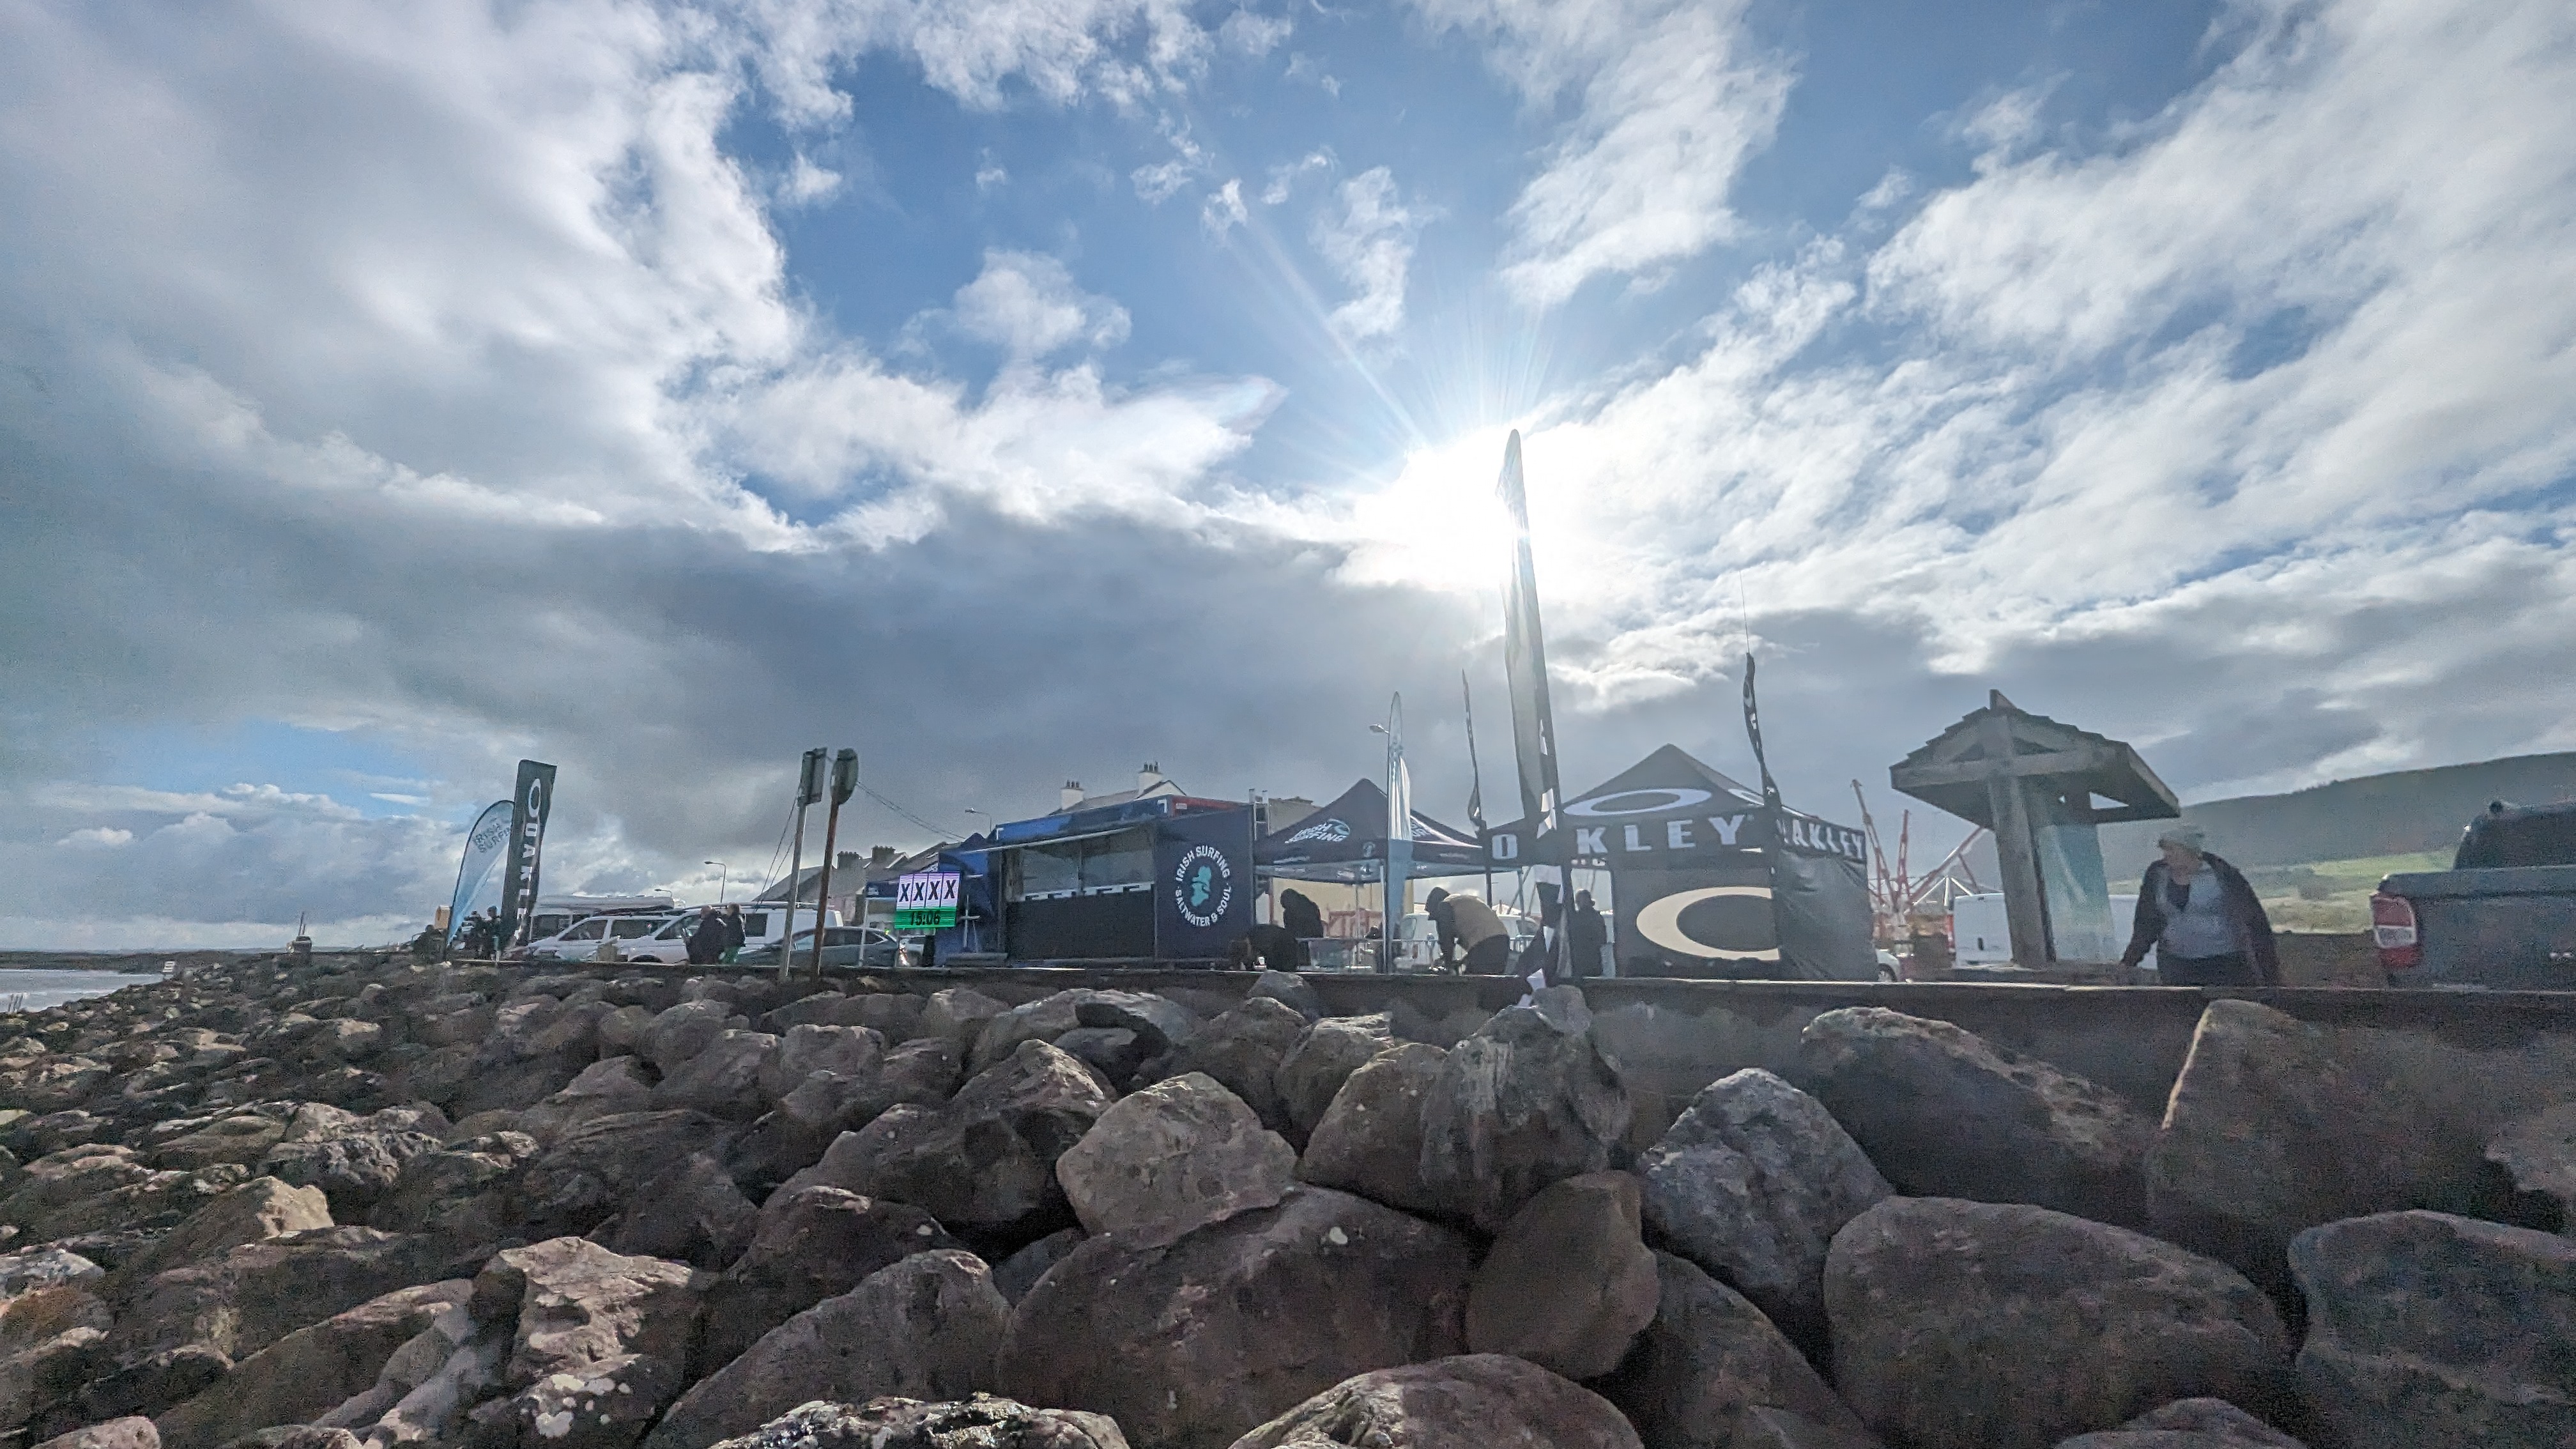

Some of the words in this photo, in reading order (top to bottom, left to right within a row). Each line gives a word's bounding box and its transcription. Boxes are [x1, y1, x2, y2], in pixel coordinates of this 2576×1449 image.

[1492, 815, 1745, 860] OKLEY
[1176, 850, 1195, 882] IRISH
[1195, 845, 1230, 878] SURFING
[1176, 889, 1211, 926] SALTWATER
[1216, 886, 1231, 915] SOUL
